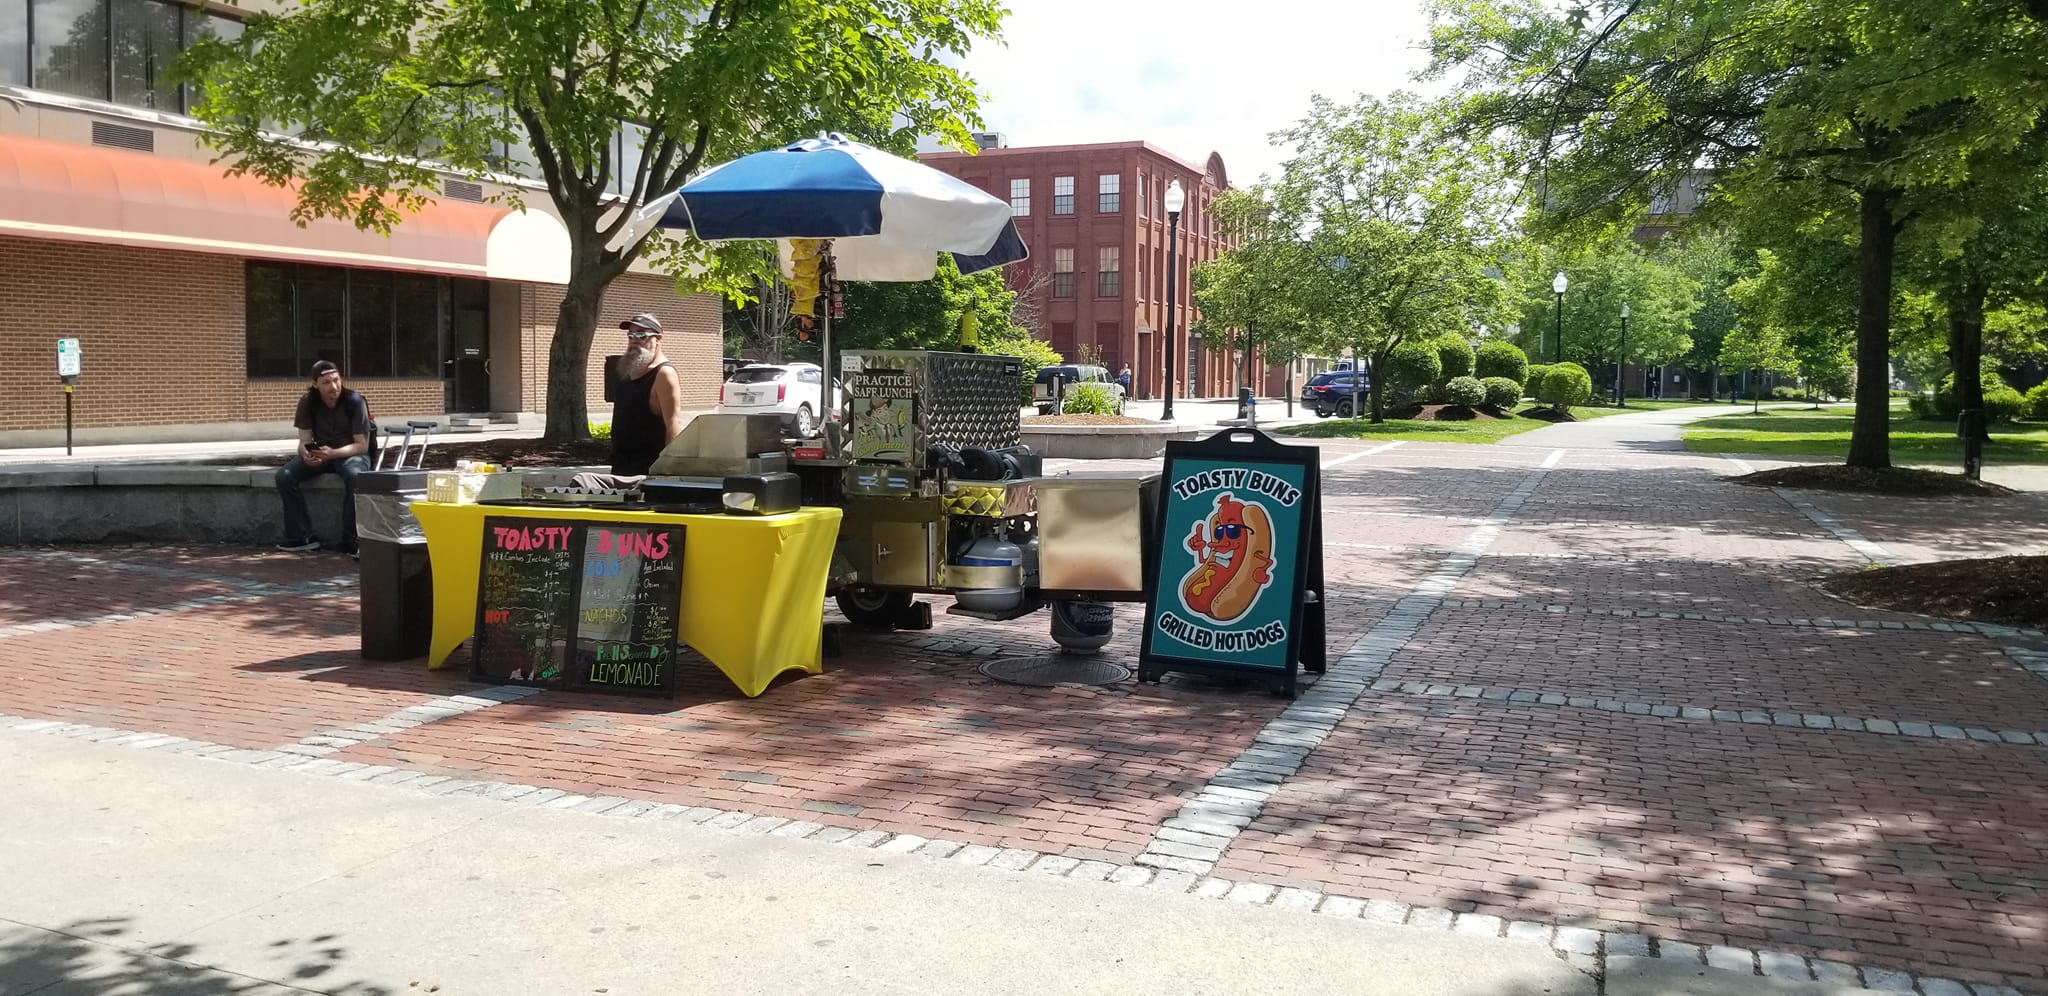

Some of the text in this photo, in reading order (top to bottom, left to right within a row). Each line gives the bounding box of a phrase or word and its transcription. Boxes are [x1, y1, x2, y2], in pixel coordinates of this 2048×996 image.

[855, 375, 912, 386] PRACTICE
[855, 386, 912, 398] SAFE LUNCH
[1174, 469, 1301, 506] TOASTY BUNS
[494, 526, 670, 560] TOASTY BUNS
[586, 560, 619, 577] COLD
[485, 610, 510, 624] HOT
[584, 608, 627, 624] NACHOS
[1159, 613, 1286, 651] GRILLED HOT DOGS
[541, 663, 560, 679] ONLY
[590, 662, 663, 686] LEMONADE
